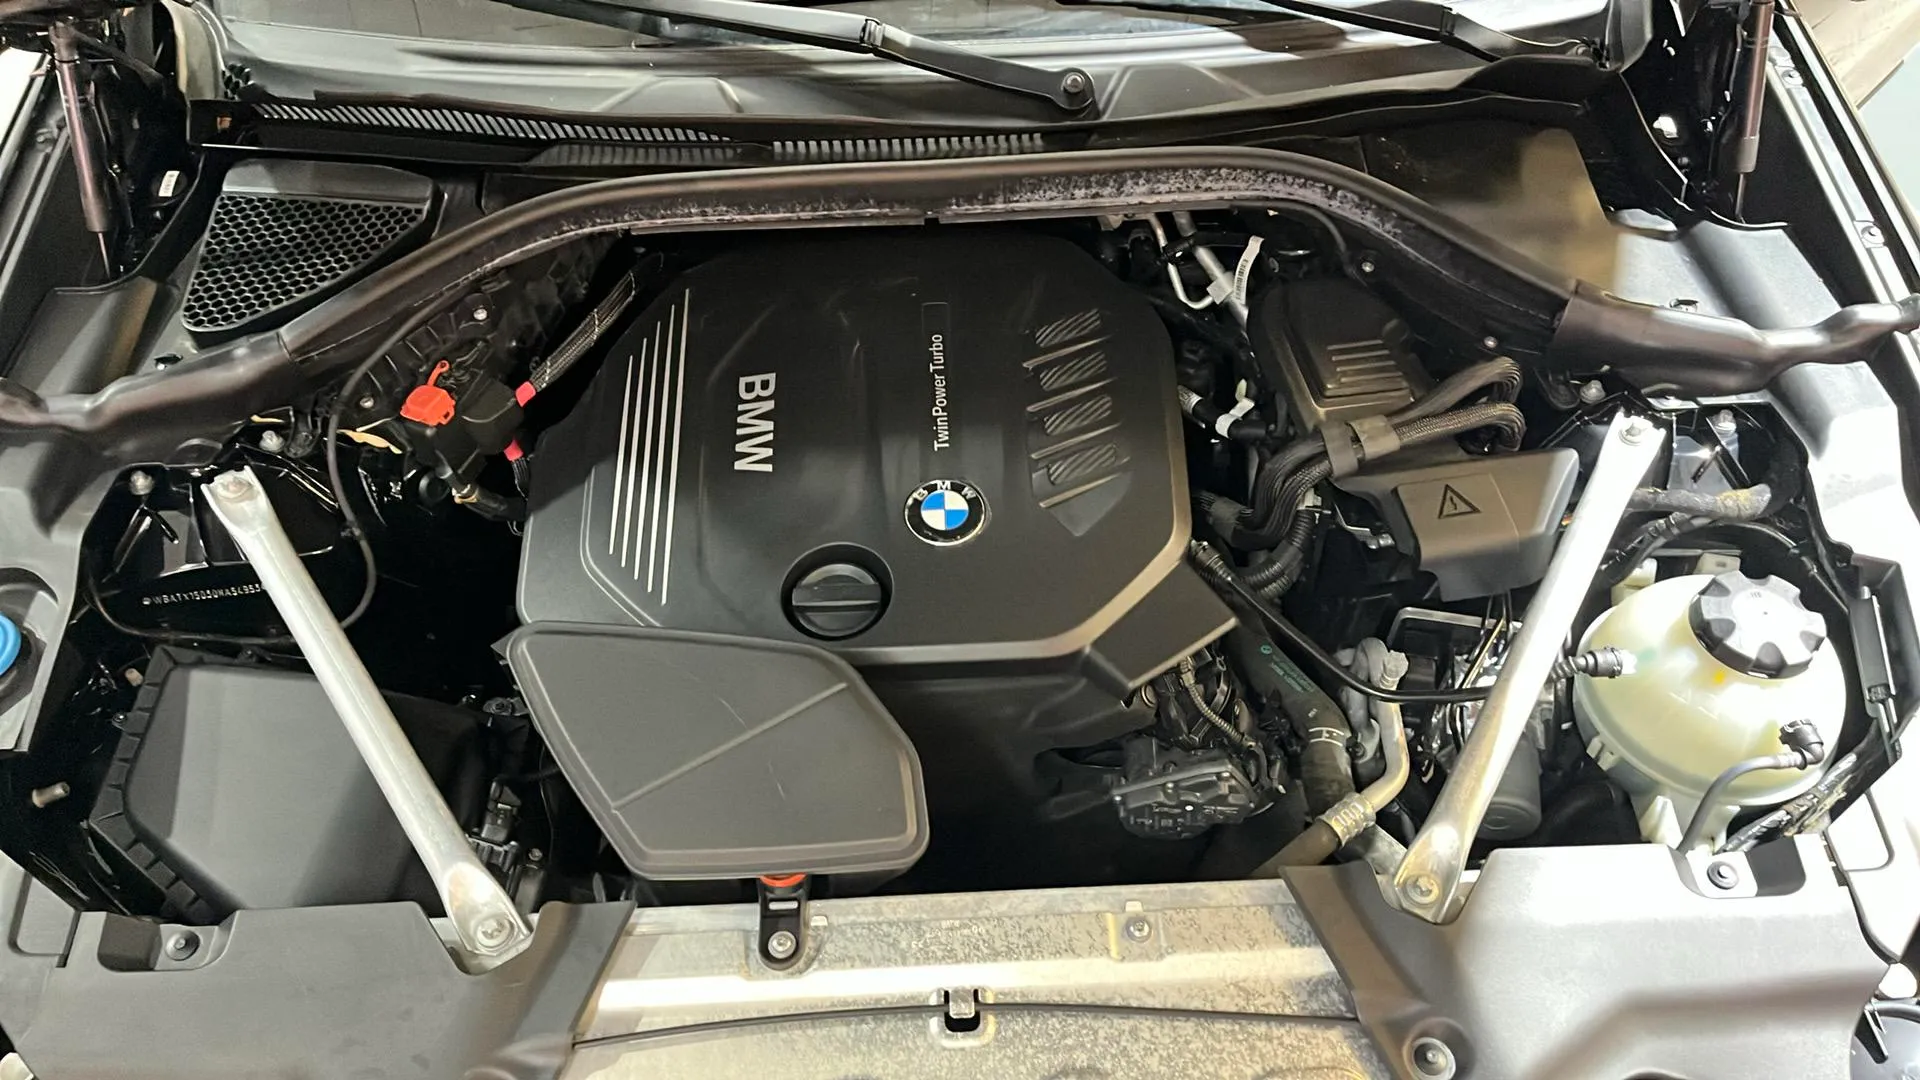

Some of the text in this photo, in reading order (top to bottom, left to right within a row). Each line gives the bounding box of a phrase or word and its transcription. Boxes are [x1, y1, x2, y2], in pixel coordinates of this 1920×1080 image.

[734, 372, 776, 472] BMW
[928, 334, 950, 452] TwinPower Turbo
[913, 480, 977, 501] BMW
